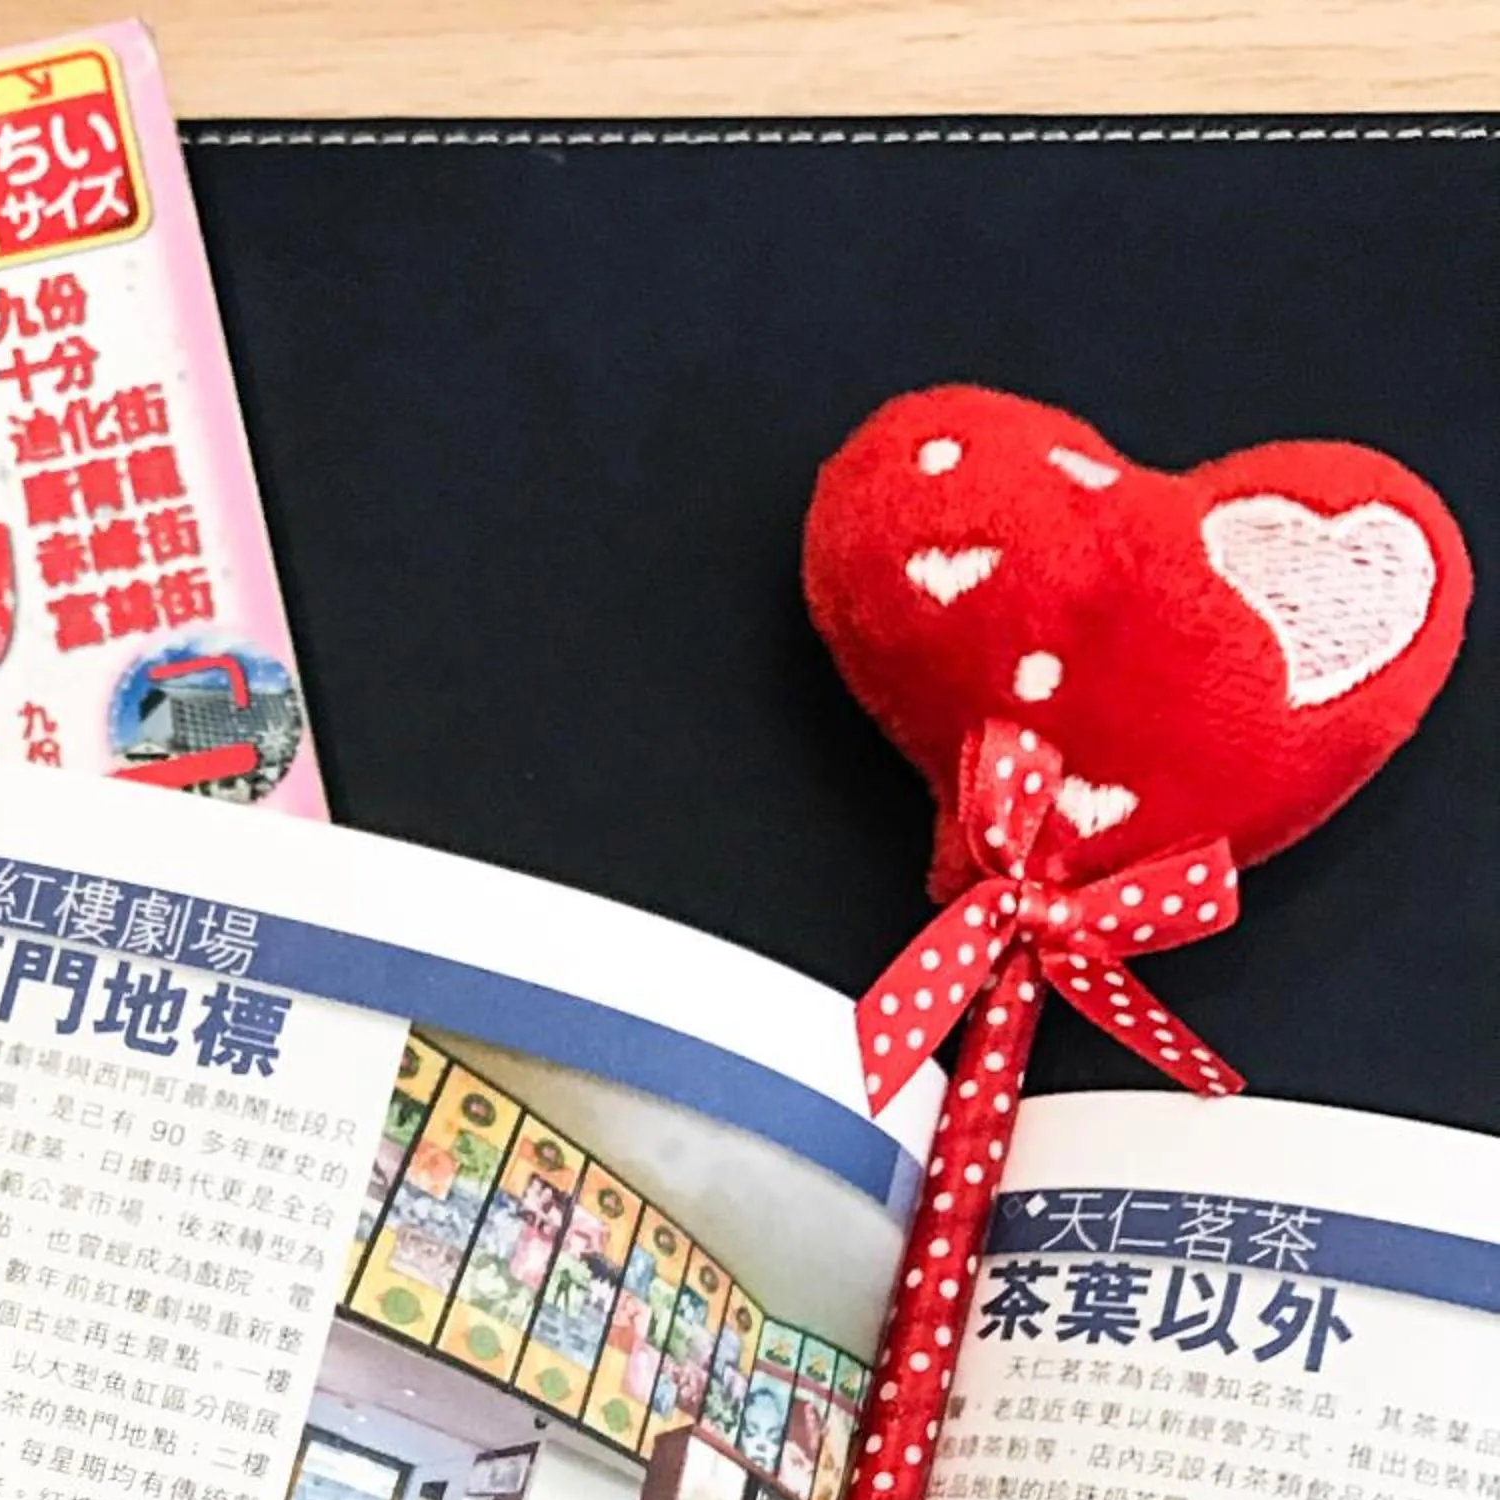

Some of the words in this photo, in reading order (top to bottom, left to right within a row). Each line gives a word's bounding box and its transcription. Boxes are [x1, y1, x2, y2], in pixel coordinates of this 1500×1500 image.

[0, 174, 131, 240] サイズ
[8, 384, 170, 465] 迪化街
[1041, 1191, 1323, 1273] 天仁茗茶
[977, 1260, 1356, 1374] 茶葉以外
